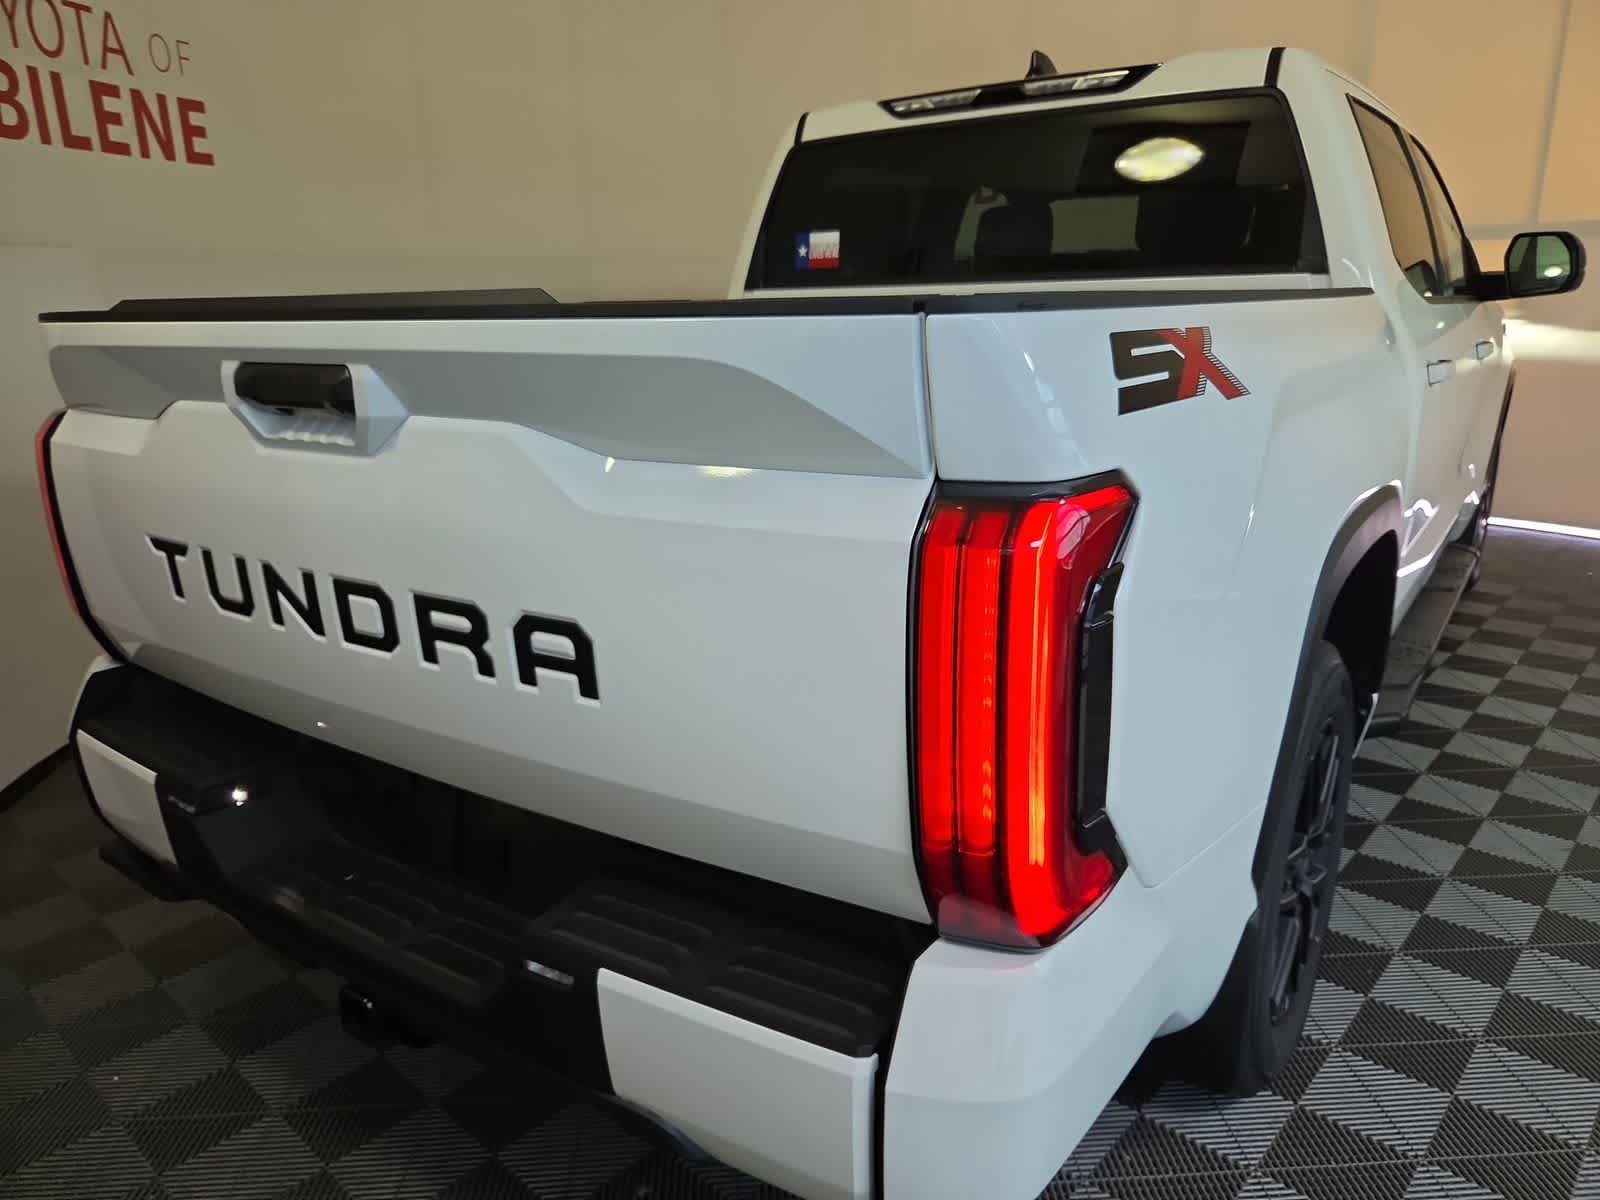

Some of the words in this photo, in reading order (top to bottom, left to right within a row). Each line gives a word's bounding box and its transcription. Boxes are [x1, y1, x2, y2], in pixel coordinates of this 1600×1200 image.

[149, 33, 191, 76] OF
[1109, 326, 1251, 416] SX
[146, 533, 600, 703] TUNDRA
